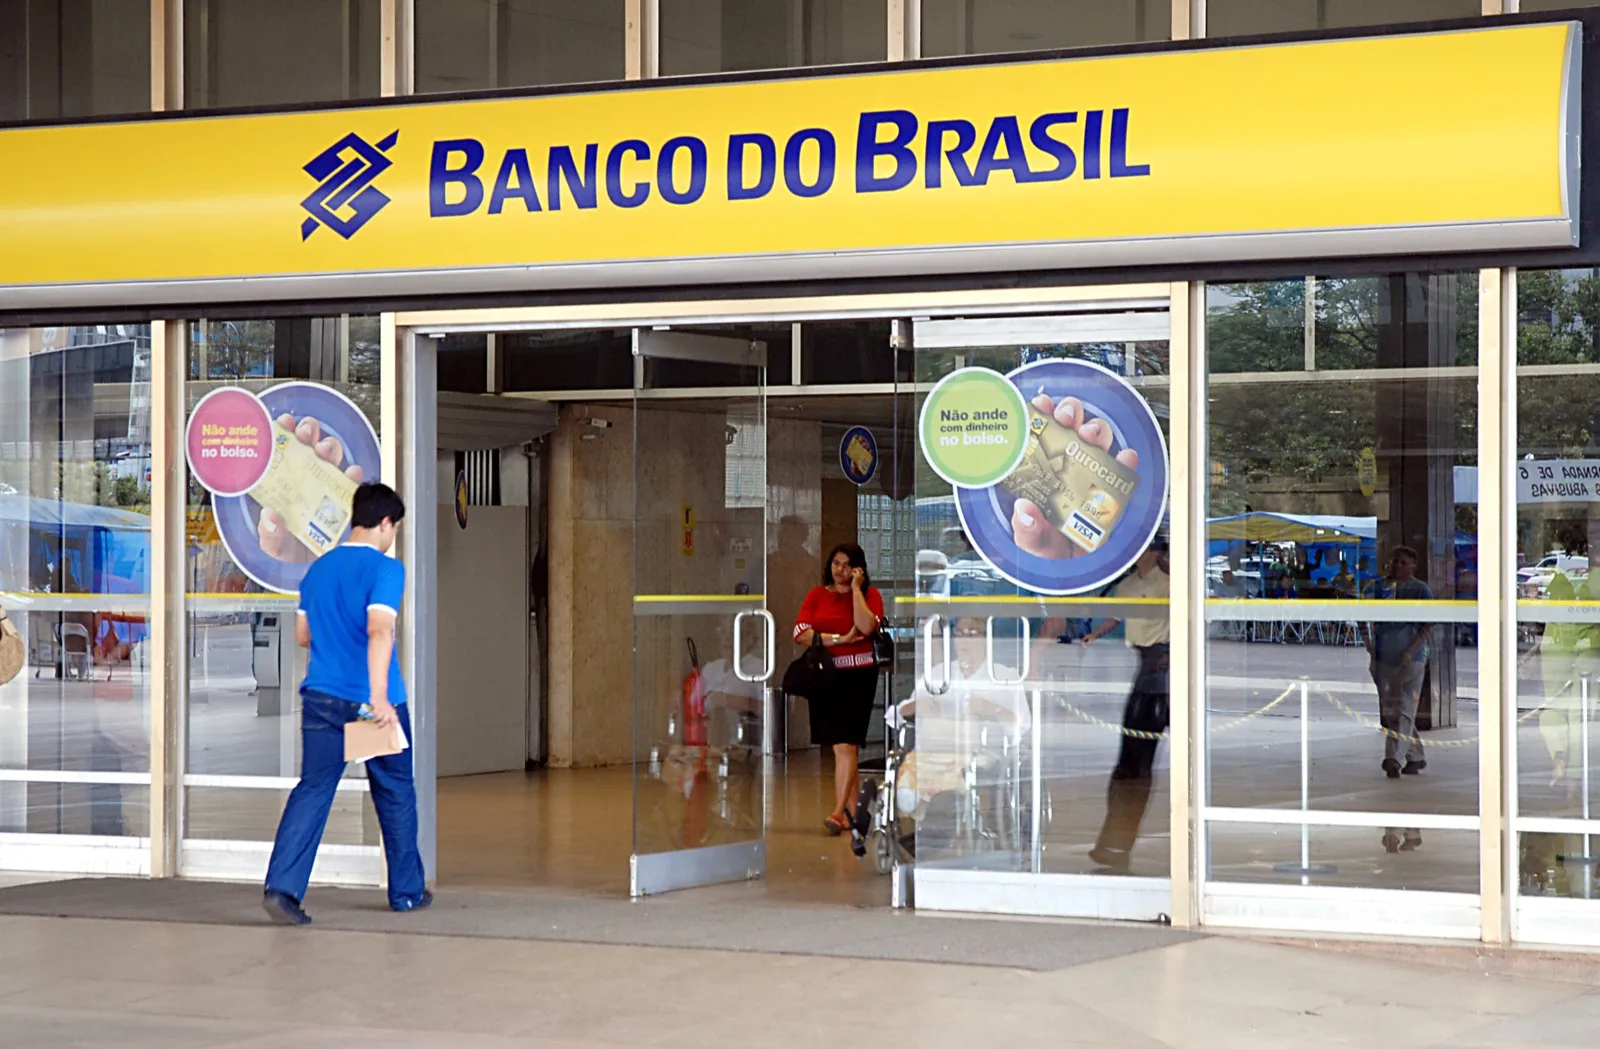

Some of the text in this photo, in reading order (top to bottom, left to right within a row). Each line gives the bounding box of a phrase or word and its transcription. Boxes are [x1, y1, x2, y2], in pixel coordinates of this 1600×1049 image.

[429, 107, 1151, 218] BANCO DO BRASIL
[940, 408, 1008, 422] Não ande
[202, 424, 258, 436] Não ande
[940, 422, 1008, 433] com dinheiro
[940, 432, 1008, 446] no bolso.
[201, 445, 258, 458] no bolso.
[1065, 440, 1135, 496] Ourocard
[308, 529, 326, 547] VISA
[1073, 521, 1094, 541] VISA
